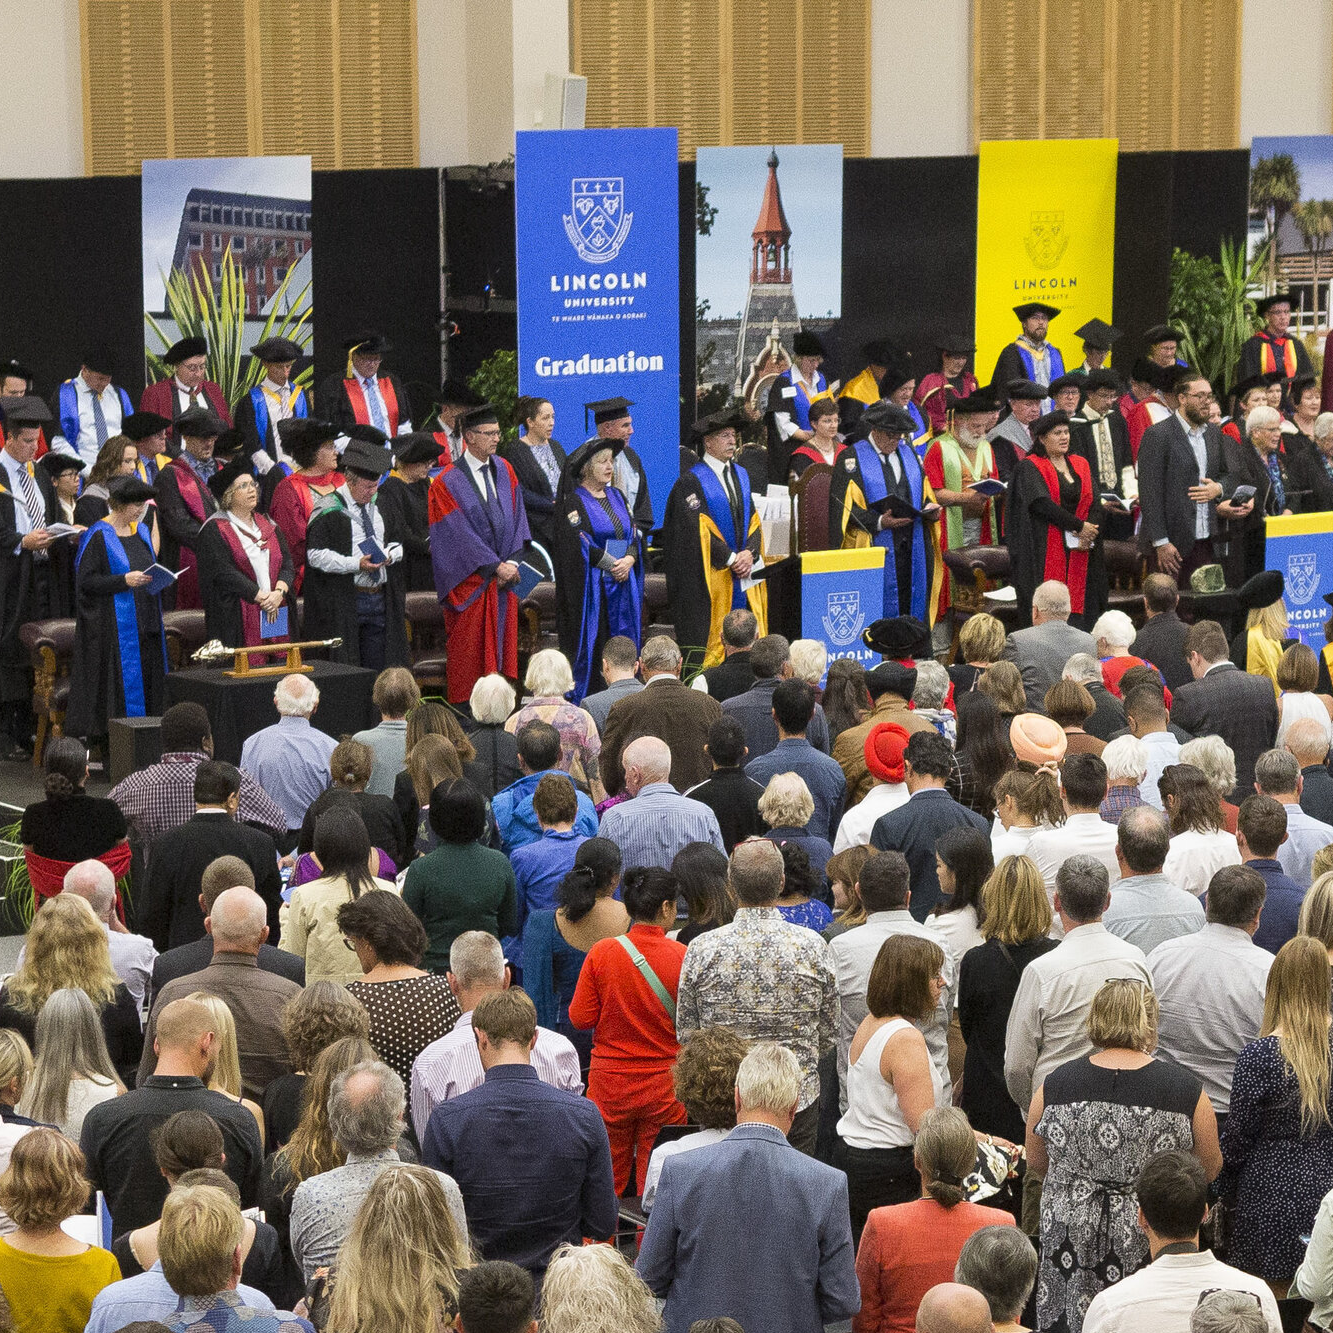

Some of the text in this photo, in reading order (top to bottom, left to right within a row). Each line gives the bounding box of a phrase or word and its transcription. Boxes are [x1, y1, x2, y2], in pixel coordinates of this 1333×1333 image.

[551, 271, 647, 292] LINCOLN
[1014, 277, 1078, 290] LINCOLN
[564, 296, 635, 308] UNIVERSITY
[562, 314, 585, 322] WHARE
[535, 350, 664, 377] Graduation
[1286, 608, 1327, 621] NCOLN
[827, 649, 873, 663] NCOLN
